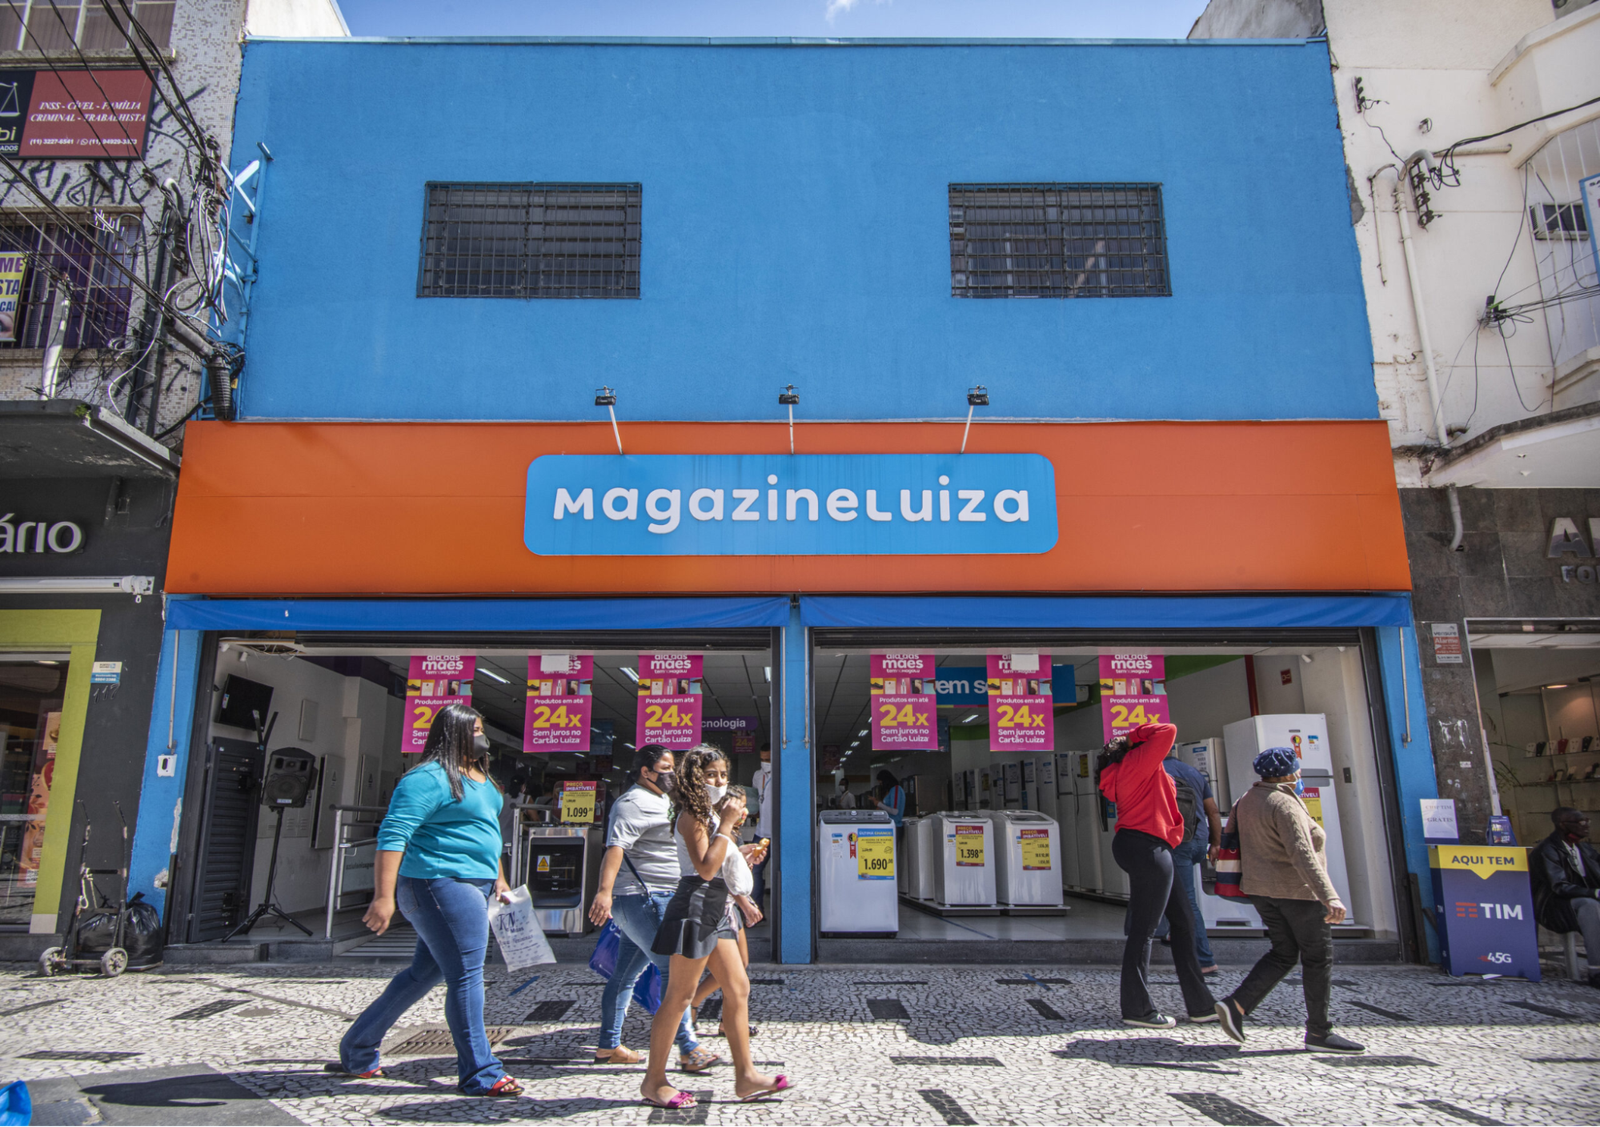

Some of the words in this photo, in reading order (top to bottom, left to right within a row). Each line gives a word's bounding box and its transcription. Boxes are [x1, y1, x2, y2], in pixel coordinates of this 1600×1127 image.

[39, 102, 61, 110] INSS
[67, 100, 94, 110] CÍVEL
[102, 100, 141, 110] FAMÍLIA
[0, 257, 24, 273] ME
[422, 659, 464, 670] mães
[650, 658, 692, 669] mães
[882, 658, 924, 669] mães
[1111, 659, 1152, 669] mães
[936, 680, 970, 694] em
[533, 705, 582, 728] 24x
[645, 705, 693, 727] 24x
[879, 704, 929, 726] 24x
[996, 705, 1045, 728] 24x
[1110, 705, 1160, 727] 24x
[702, 718, 746, 729] cnologia
[551, 729, 570, 737] juros
[567, 808, 588, 817] 1.099
[961, 849, 979, 858] 1.398
[864, 858, 887, 870] 1.690
[1452, 856, 1484, 865] AQUI
[1487, 856, 1514, 865] TEM
[1480, 903, 1523, 920] TIM
